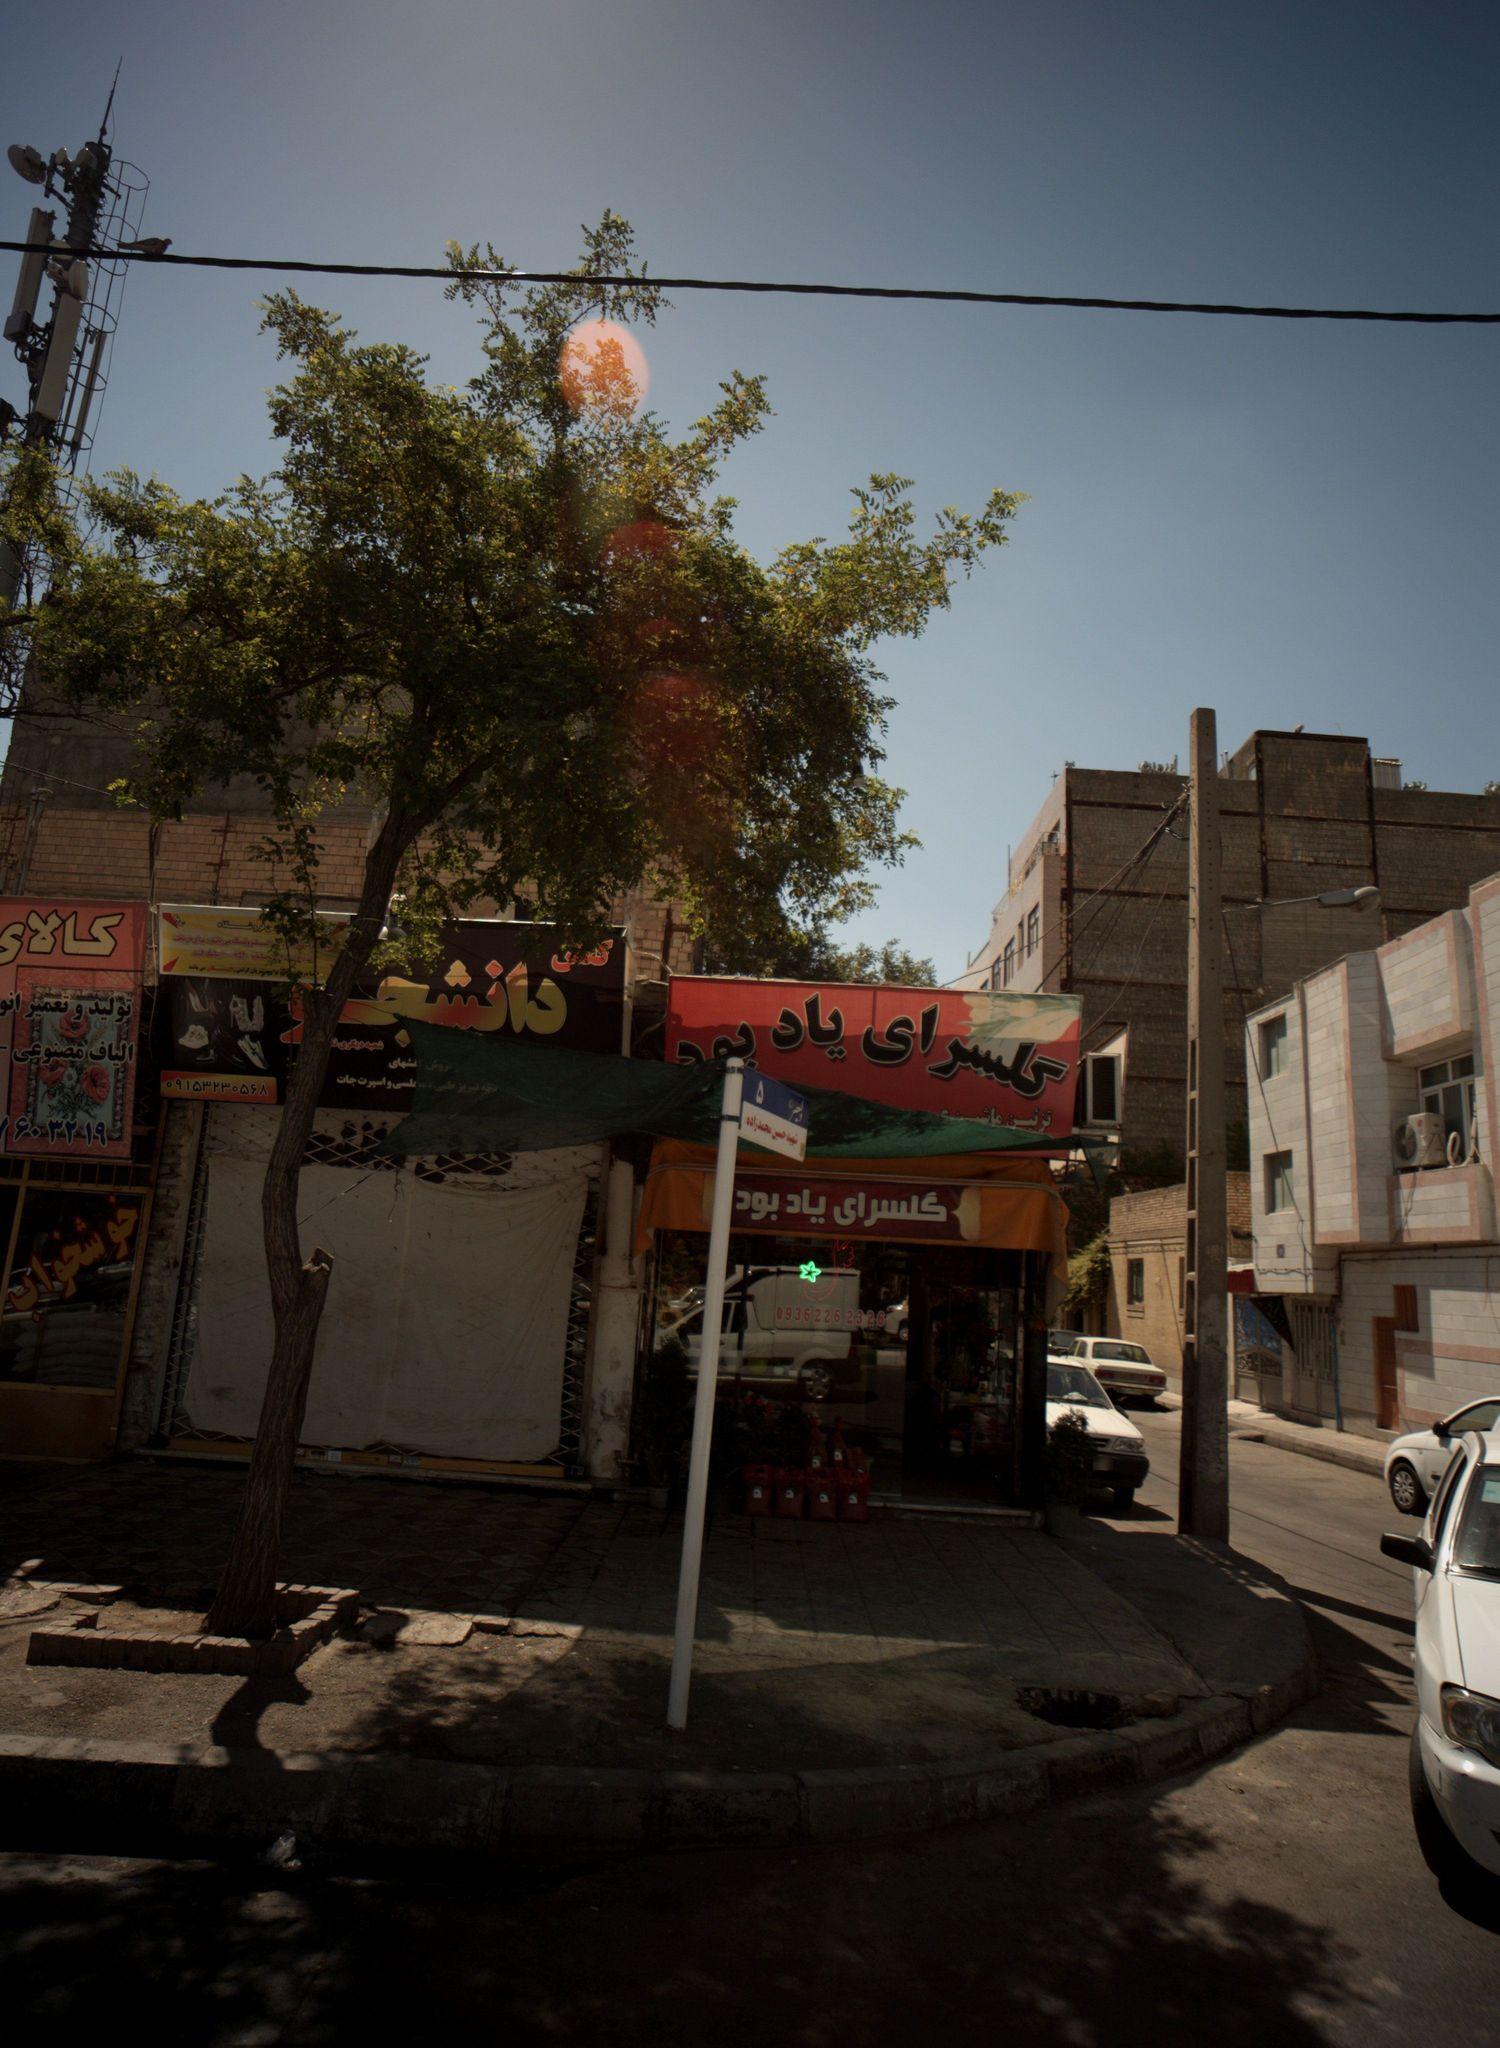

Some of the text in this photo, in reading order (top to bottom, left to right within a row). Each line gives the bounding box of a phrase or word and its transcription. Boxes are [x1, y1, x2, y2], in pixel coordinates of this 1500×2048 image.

[25, 995, 69, 1019] تعمیر
[73, 1006, 84, 1020] و
[88, 995, 133, 1023] تولید
[13, 1043, 134, 1065] الیاف مصنوعی
[735, 1188, 948, 1227] گلسرای یاد بود
